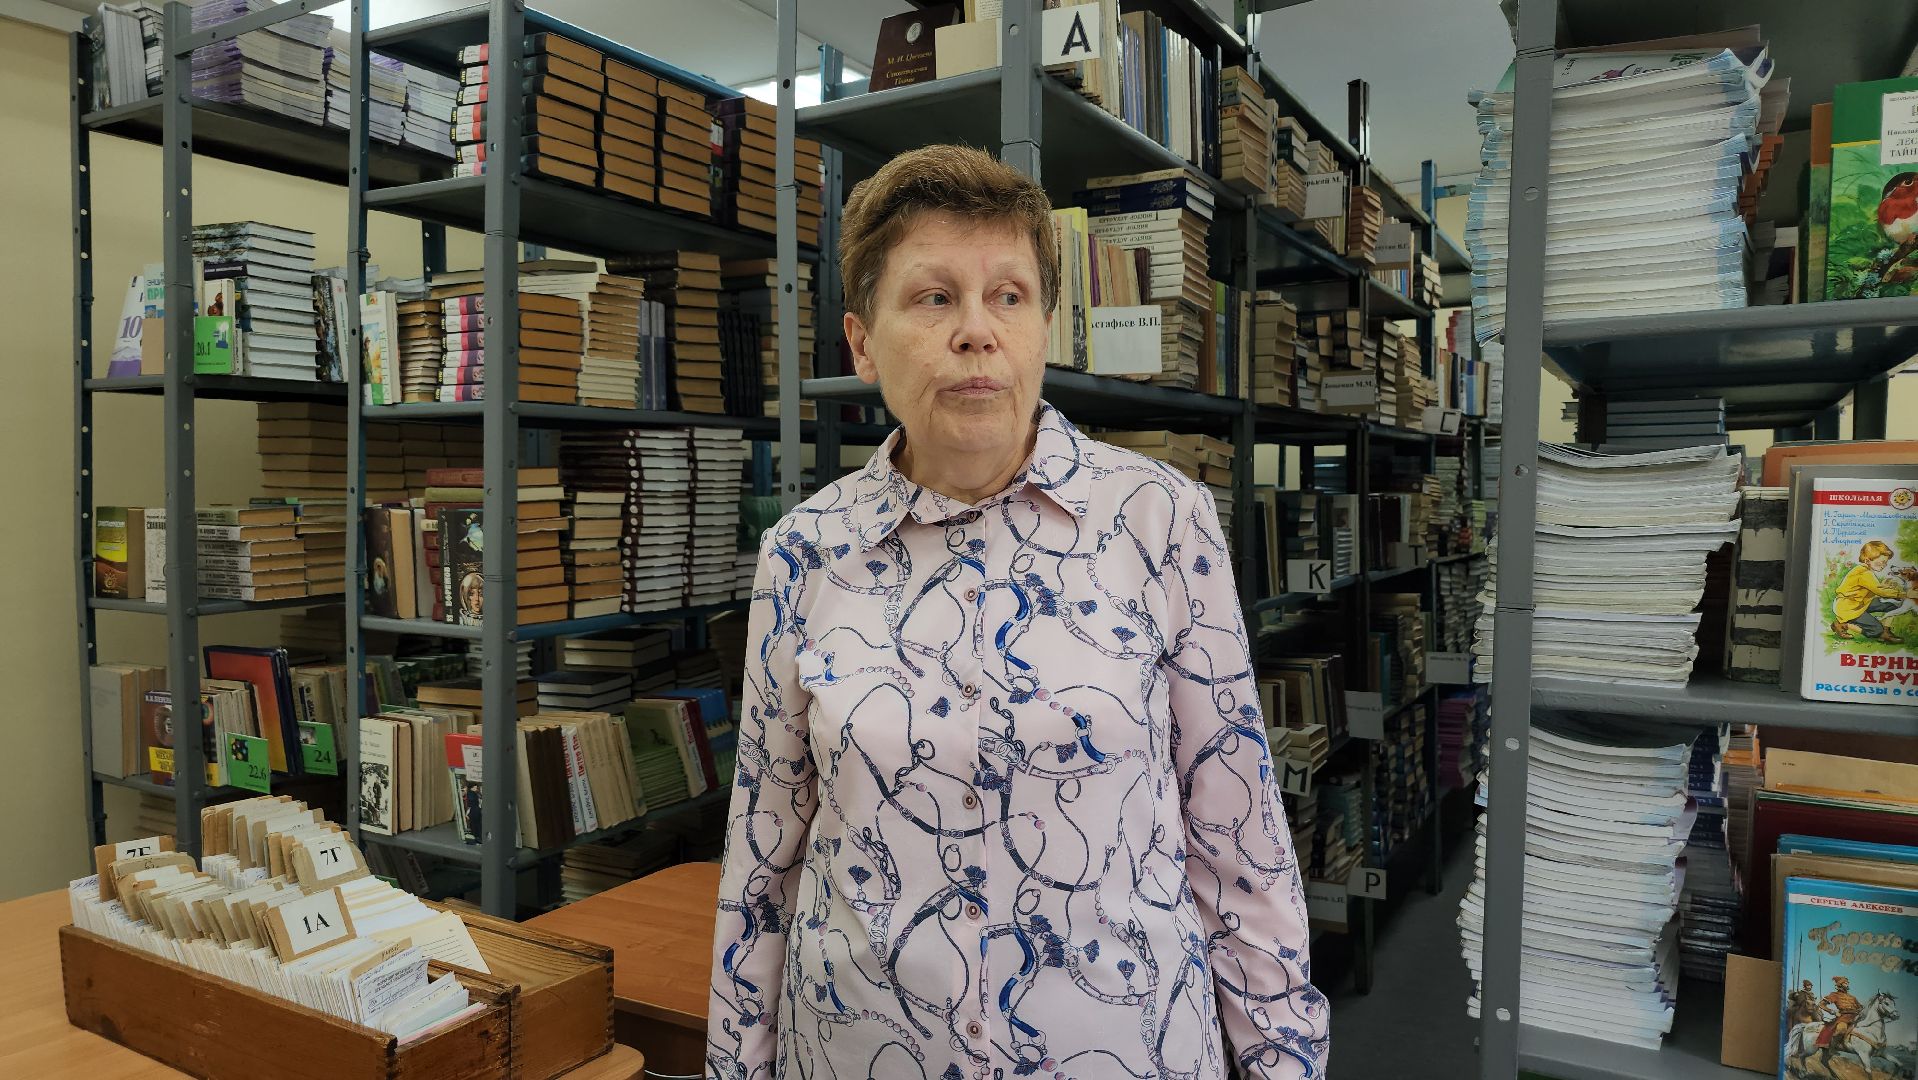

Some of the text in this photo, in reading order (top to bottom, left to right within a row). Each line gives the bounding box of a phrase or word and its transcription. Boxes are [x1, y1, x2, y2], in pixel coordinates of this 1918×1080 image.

[1061, 11, 1091, 56] А
[120, 315, 142, 339] 10
[1139, 317, 1161, 327] В.П.
[1829, 494, 1883, 502] ШКОЛЬНАЯ
[1408, 544, 1423, 566] Т
[1308, 562, 1327, 590] К
[1860, 670, 1918, 686] ДРУ
[1815, 683, 1888, 695] рассказы
[314, 749, 331, 763] 24
[248, 764, 267, 780] 22.6
[1283, 762, 1308, 793] М
[1365, 872, 1381, 893] Р
[1810, 897, 1903, 913] СЕРГЕЙ АЛЕКСЕЕВ
